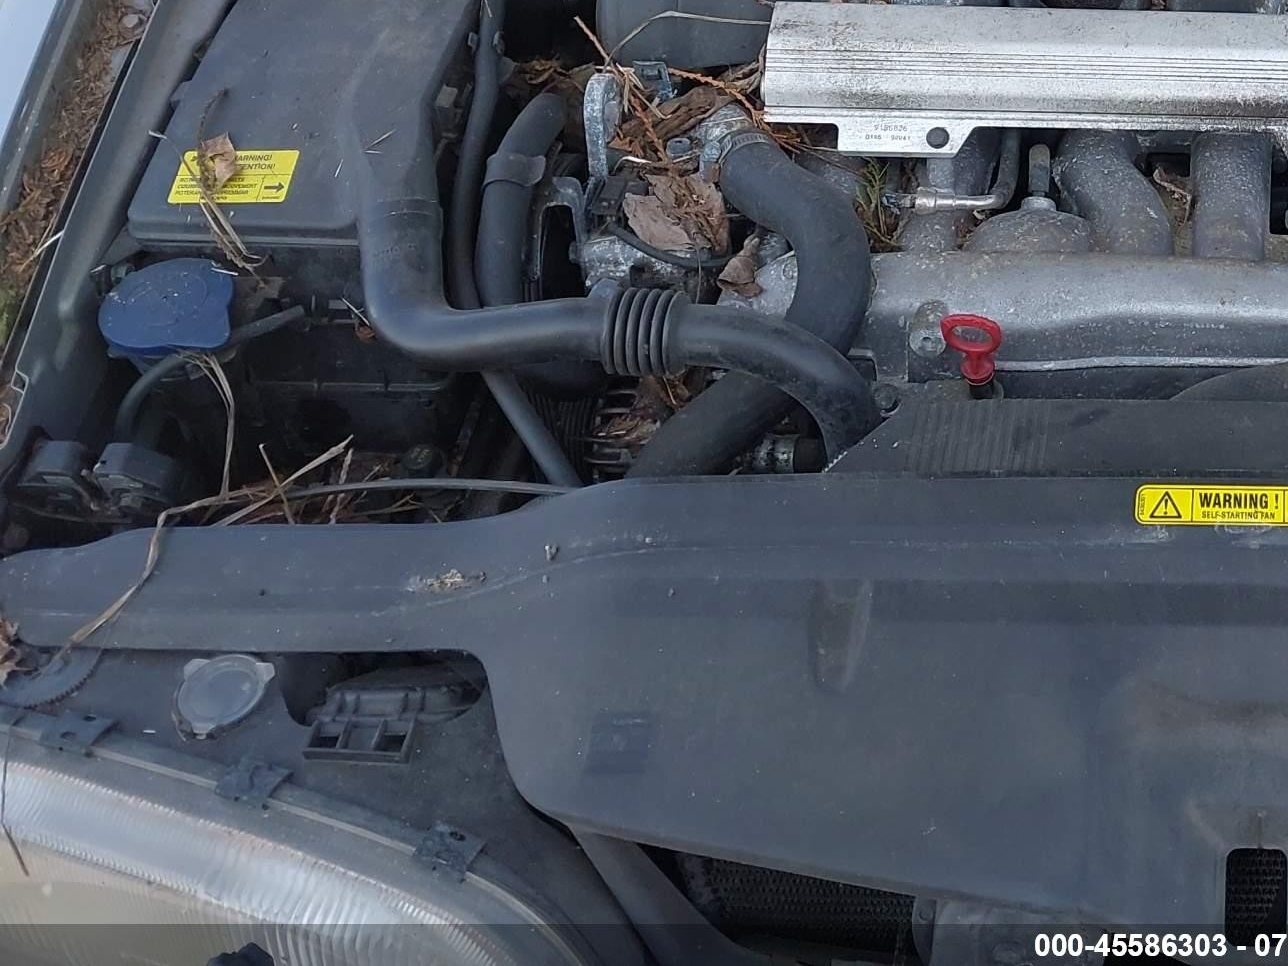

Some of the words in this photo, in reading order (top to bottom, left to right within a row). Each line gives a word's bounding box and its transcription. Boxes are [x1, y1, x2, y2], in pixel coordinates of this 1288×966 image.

[1199, 493, 1268, 509] WARNING
[1274, 494, 1279, 509] !
[1202, 510, 1259, 520] SELF-STARTING
[1261, 511, 1275, 520] FAN
